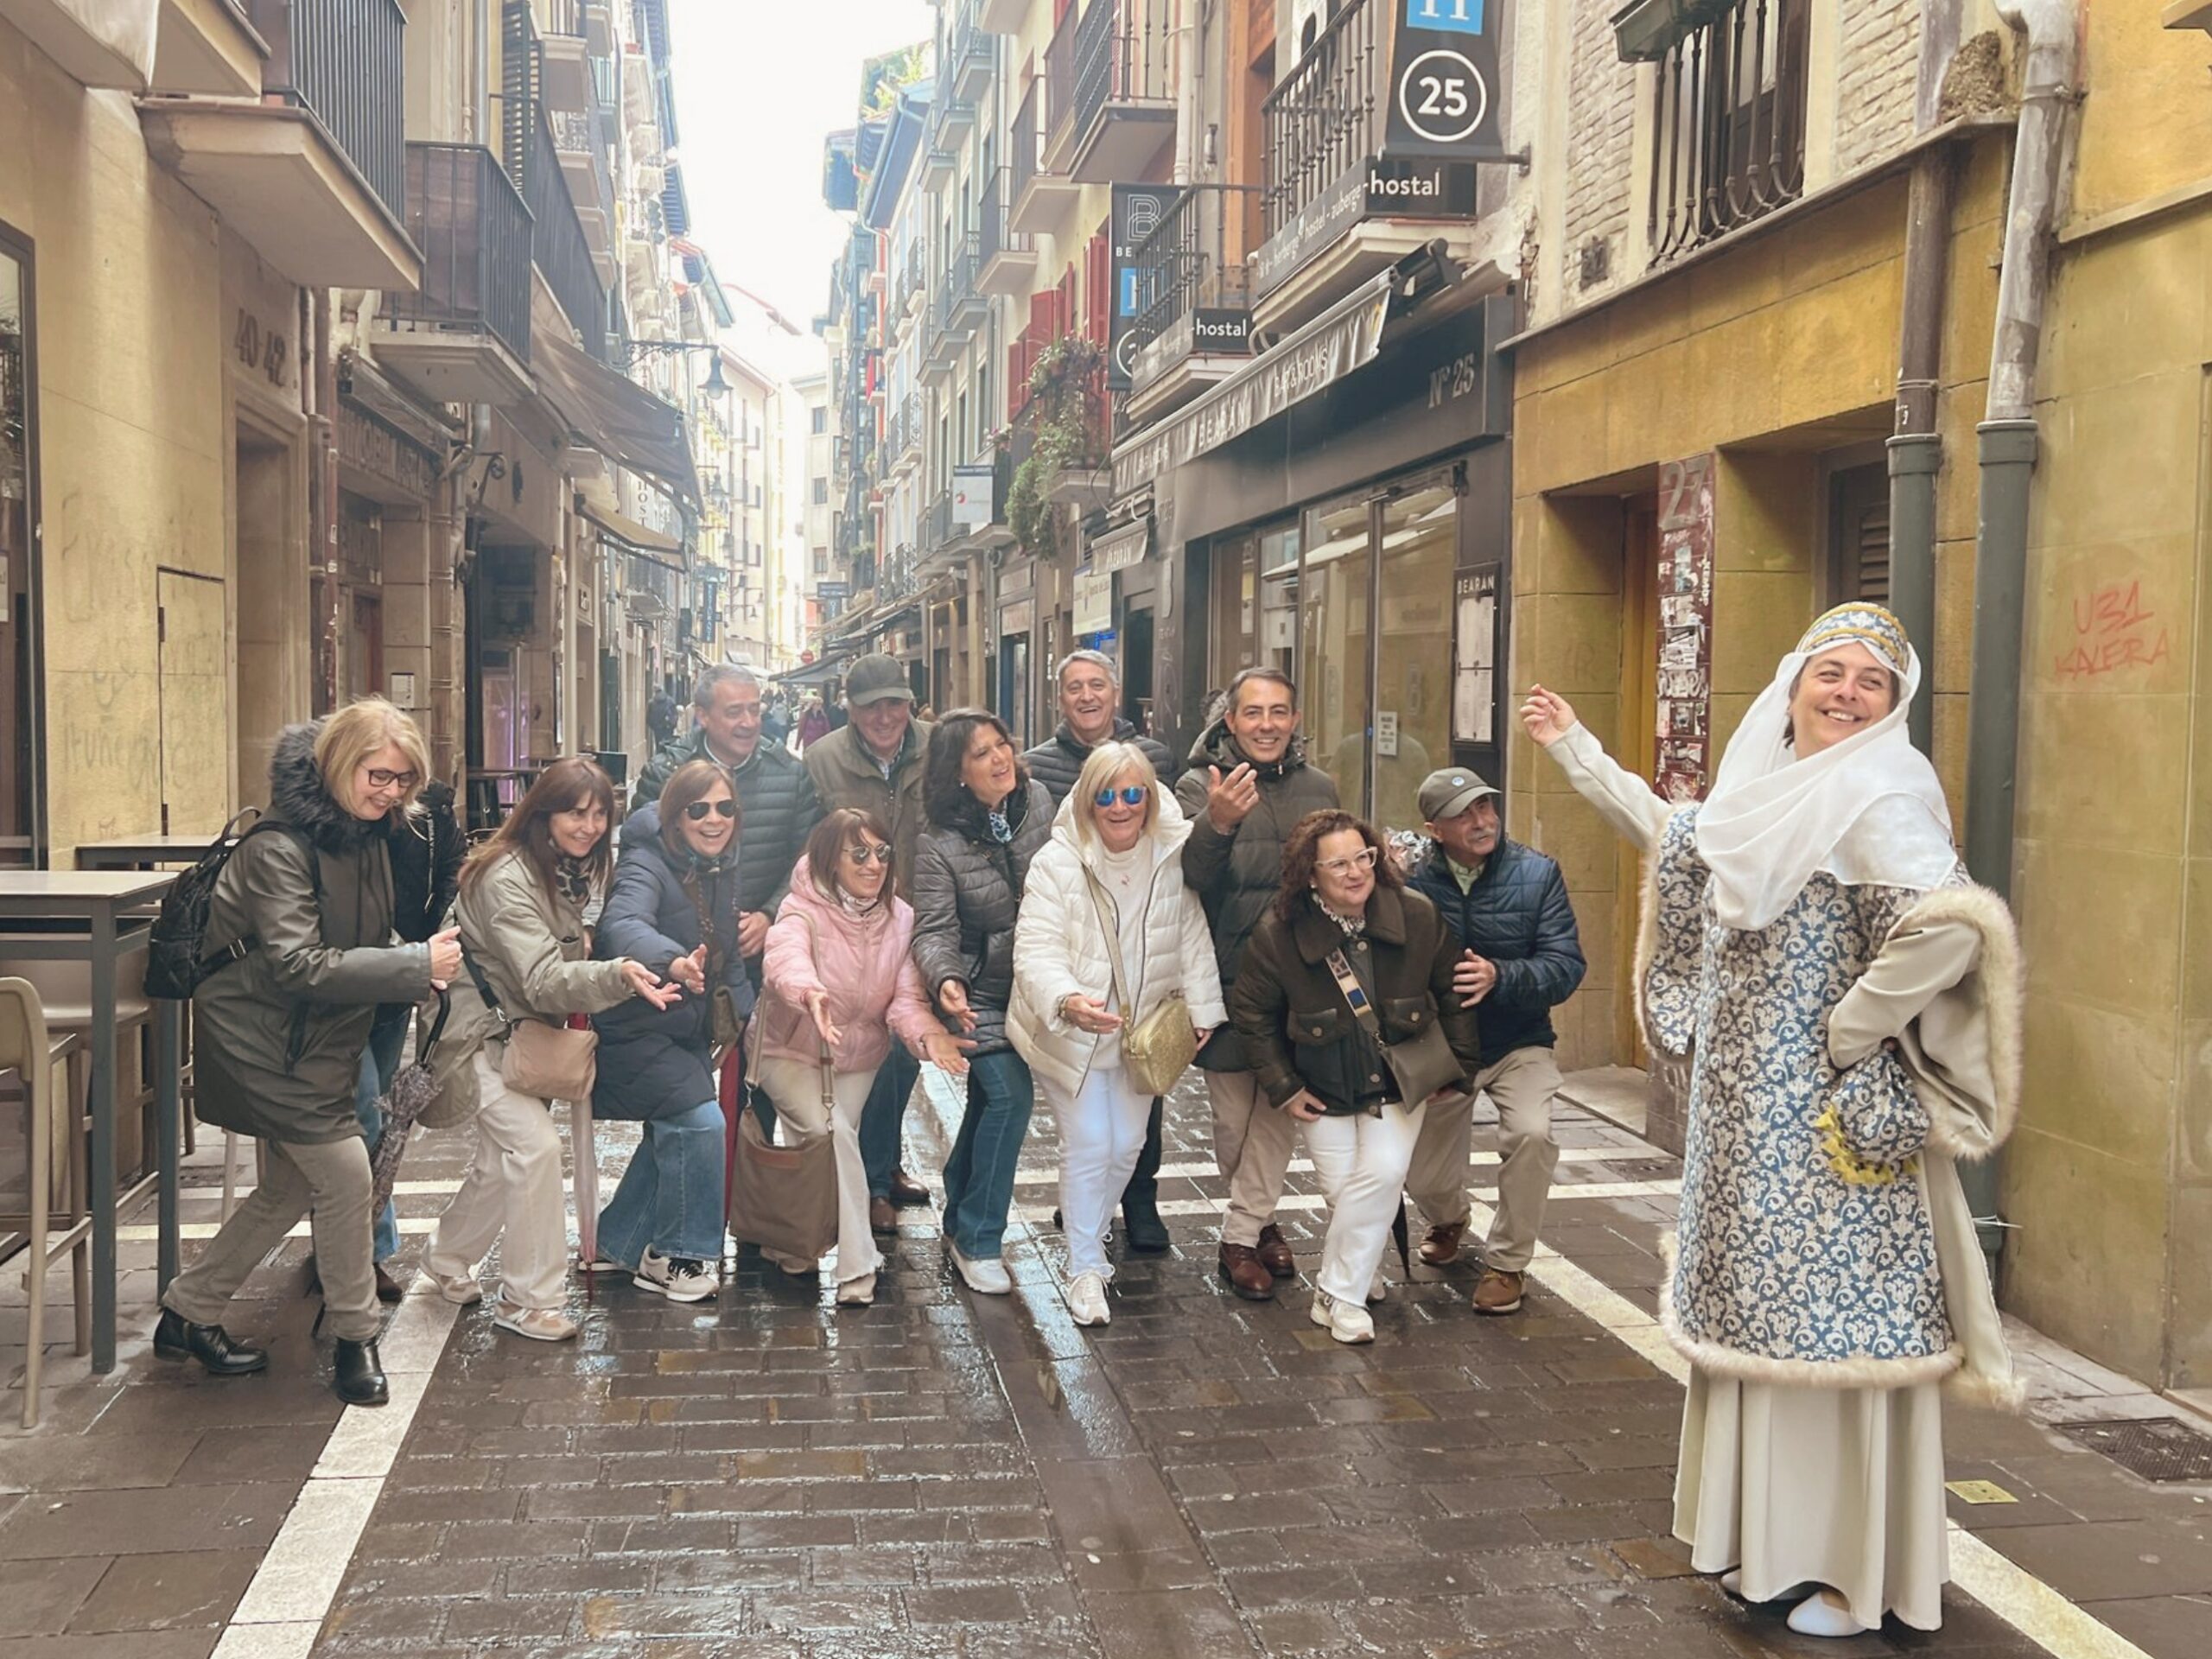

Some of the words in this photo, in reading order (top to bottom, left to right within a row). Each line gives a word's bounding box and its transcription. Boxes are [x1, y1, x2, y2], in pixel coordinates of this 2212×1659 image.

[1418, 76, 1467, 117] 25
[1370, 169, 1440, 196] hostal
[1452, 353, 1474, 398] 25
[1658, 457, 1711, 532] 27
[1457, 575, 1495, 594] BEARAN
